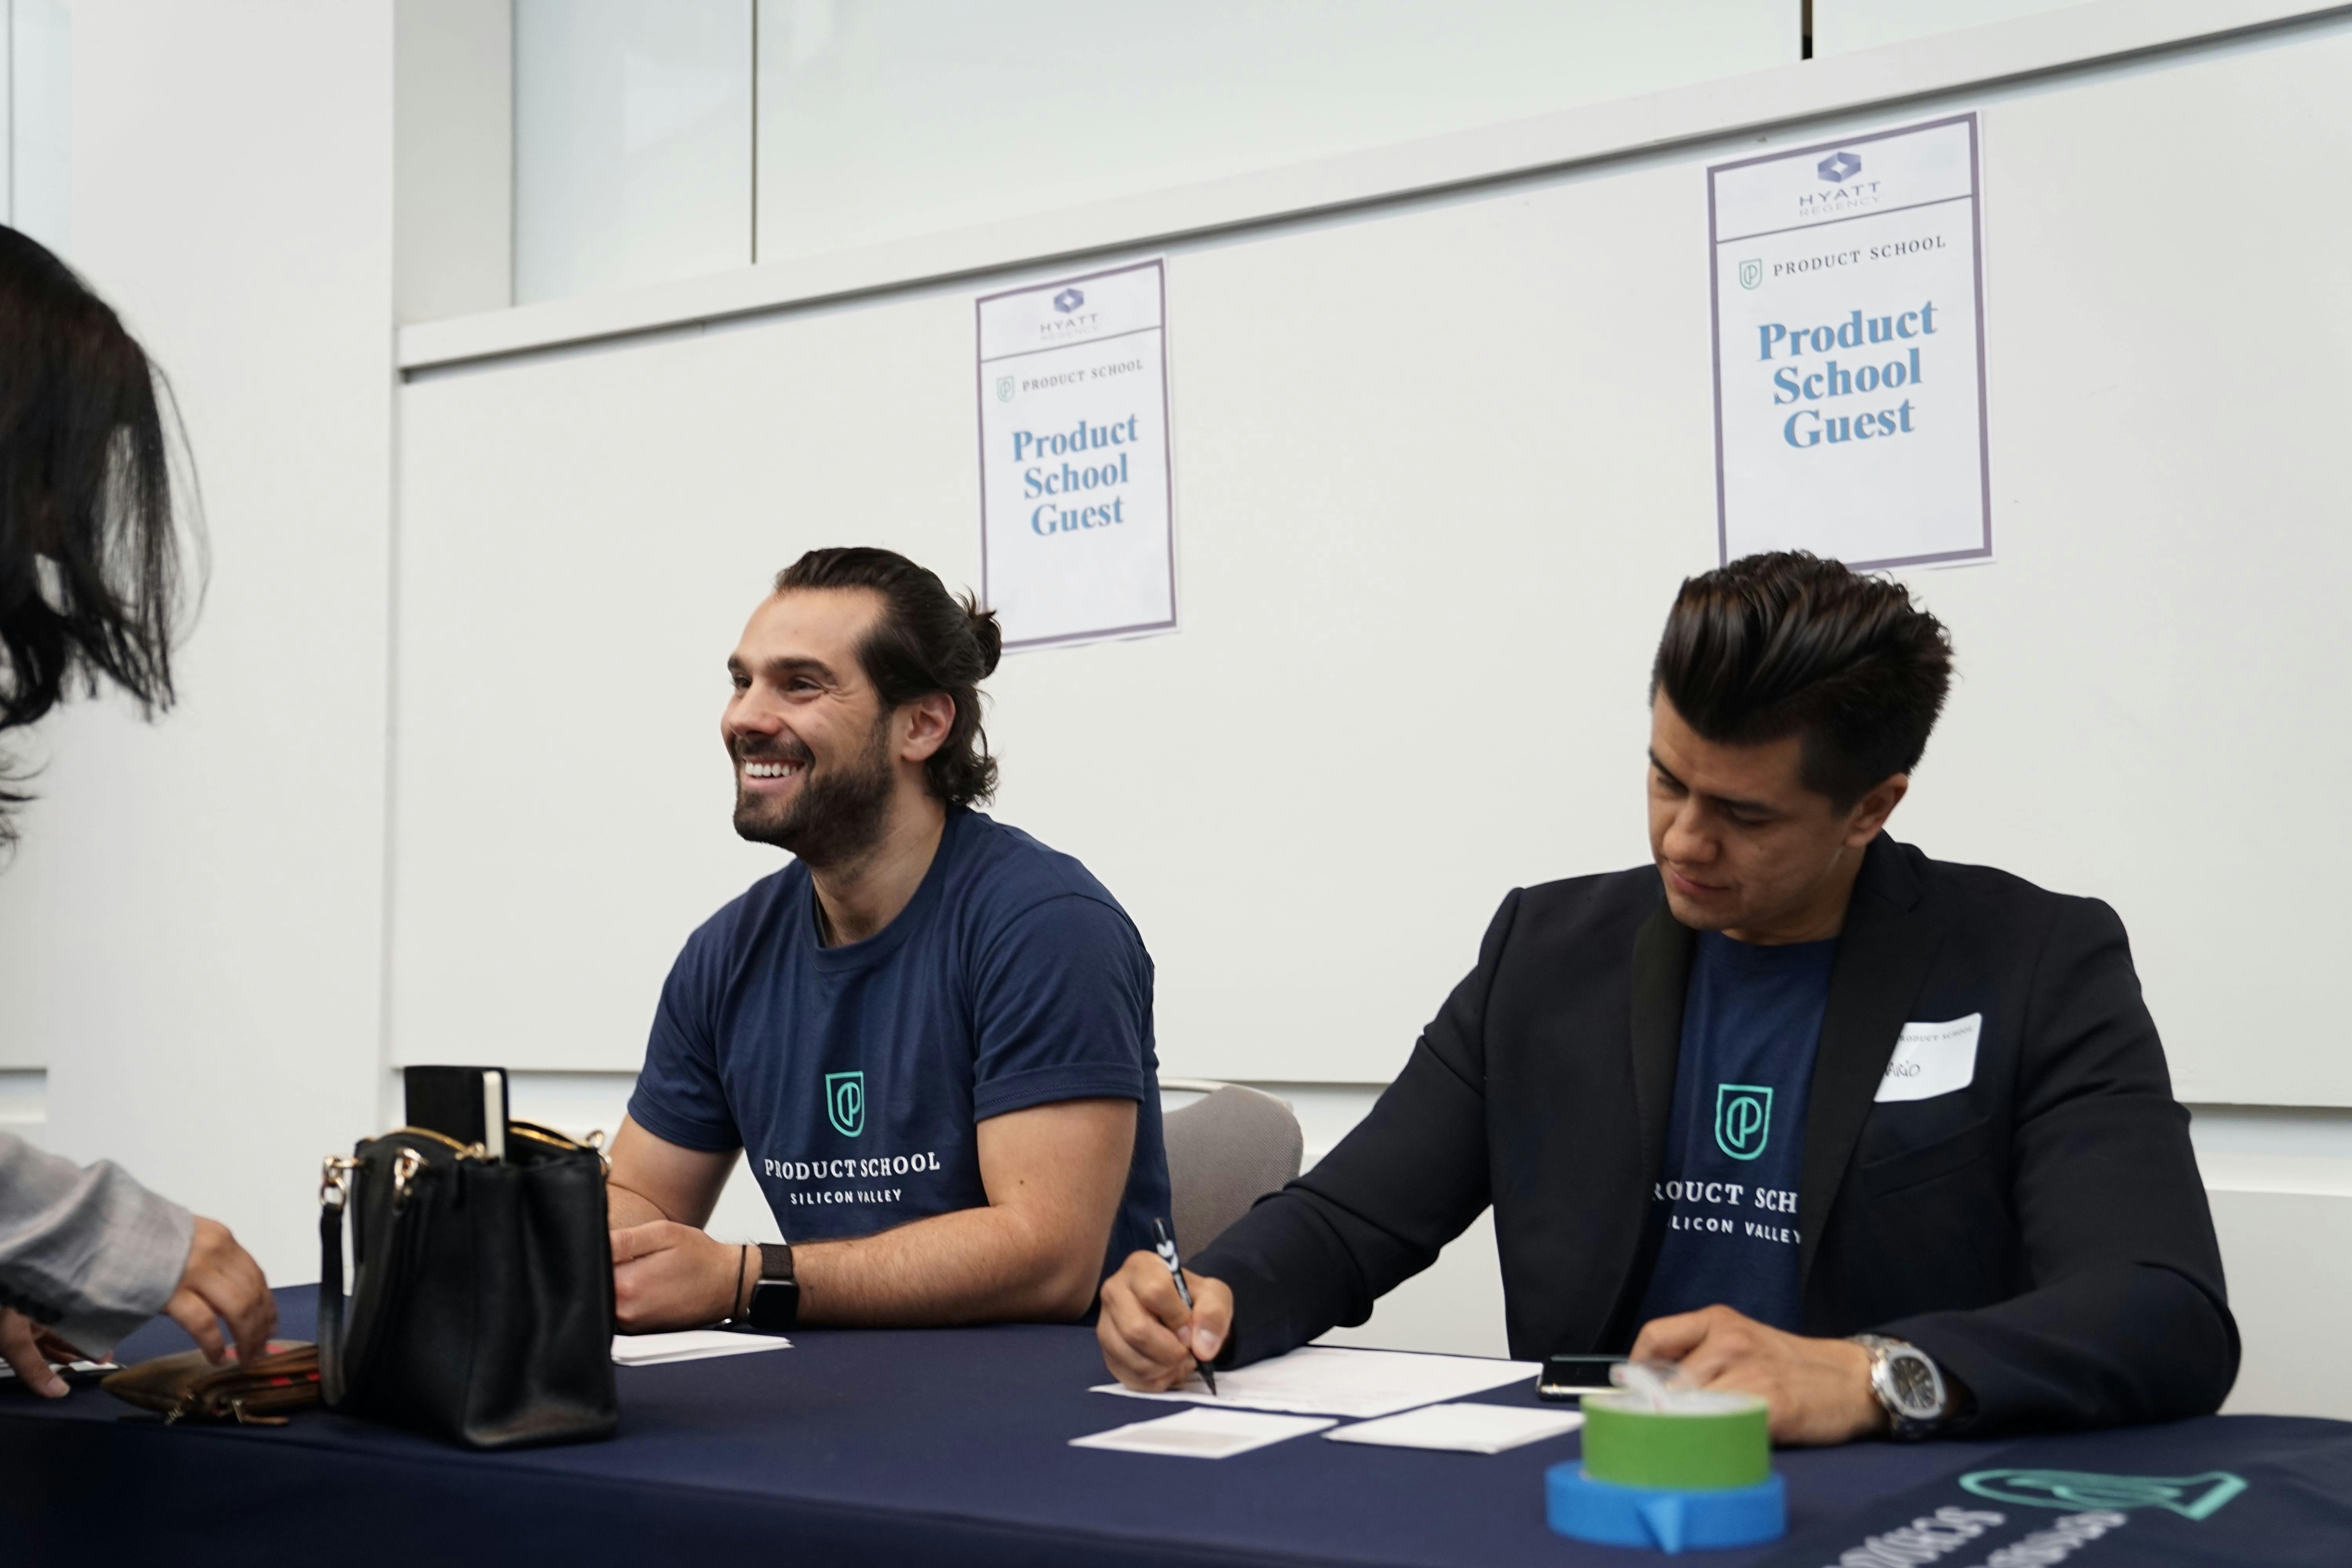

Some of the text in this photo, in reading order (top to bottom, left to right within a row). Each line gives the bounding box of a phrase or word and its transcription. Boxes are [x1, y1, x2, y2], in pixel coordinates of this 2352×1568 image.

[1799, 181, 1881, 206] HYATT
[1799, 195, 1882, 217] REGENCY
[1773, 235, 1946, 277] PRODUCT SCHOOL
[1040, 313, 1098, 333] HYATT
[1757, 300, 1938, 361] Product
[1022, 359, 1143, 392] PRODUCT SCHOOL
[1773, 347, 1922, 405] School
[1013, 413, 1139, 462] Product
[1783, 398, 1916, 448] Guest
[1024, 452, 1129, 499] School
[1031, 495, 1124, 536] Guest
[764, 1152, 940, 1180] PRODUCT SCHOOL
[790, 1189, 902, 1205] SILICON VALLEY
[1754, 1187, 1798, 1214] SCH
[1670, 1215, 1734, 1234] LICON
